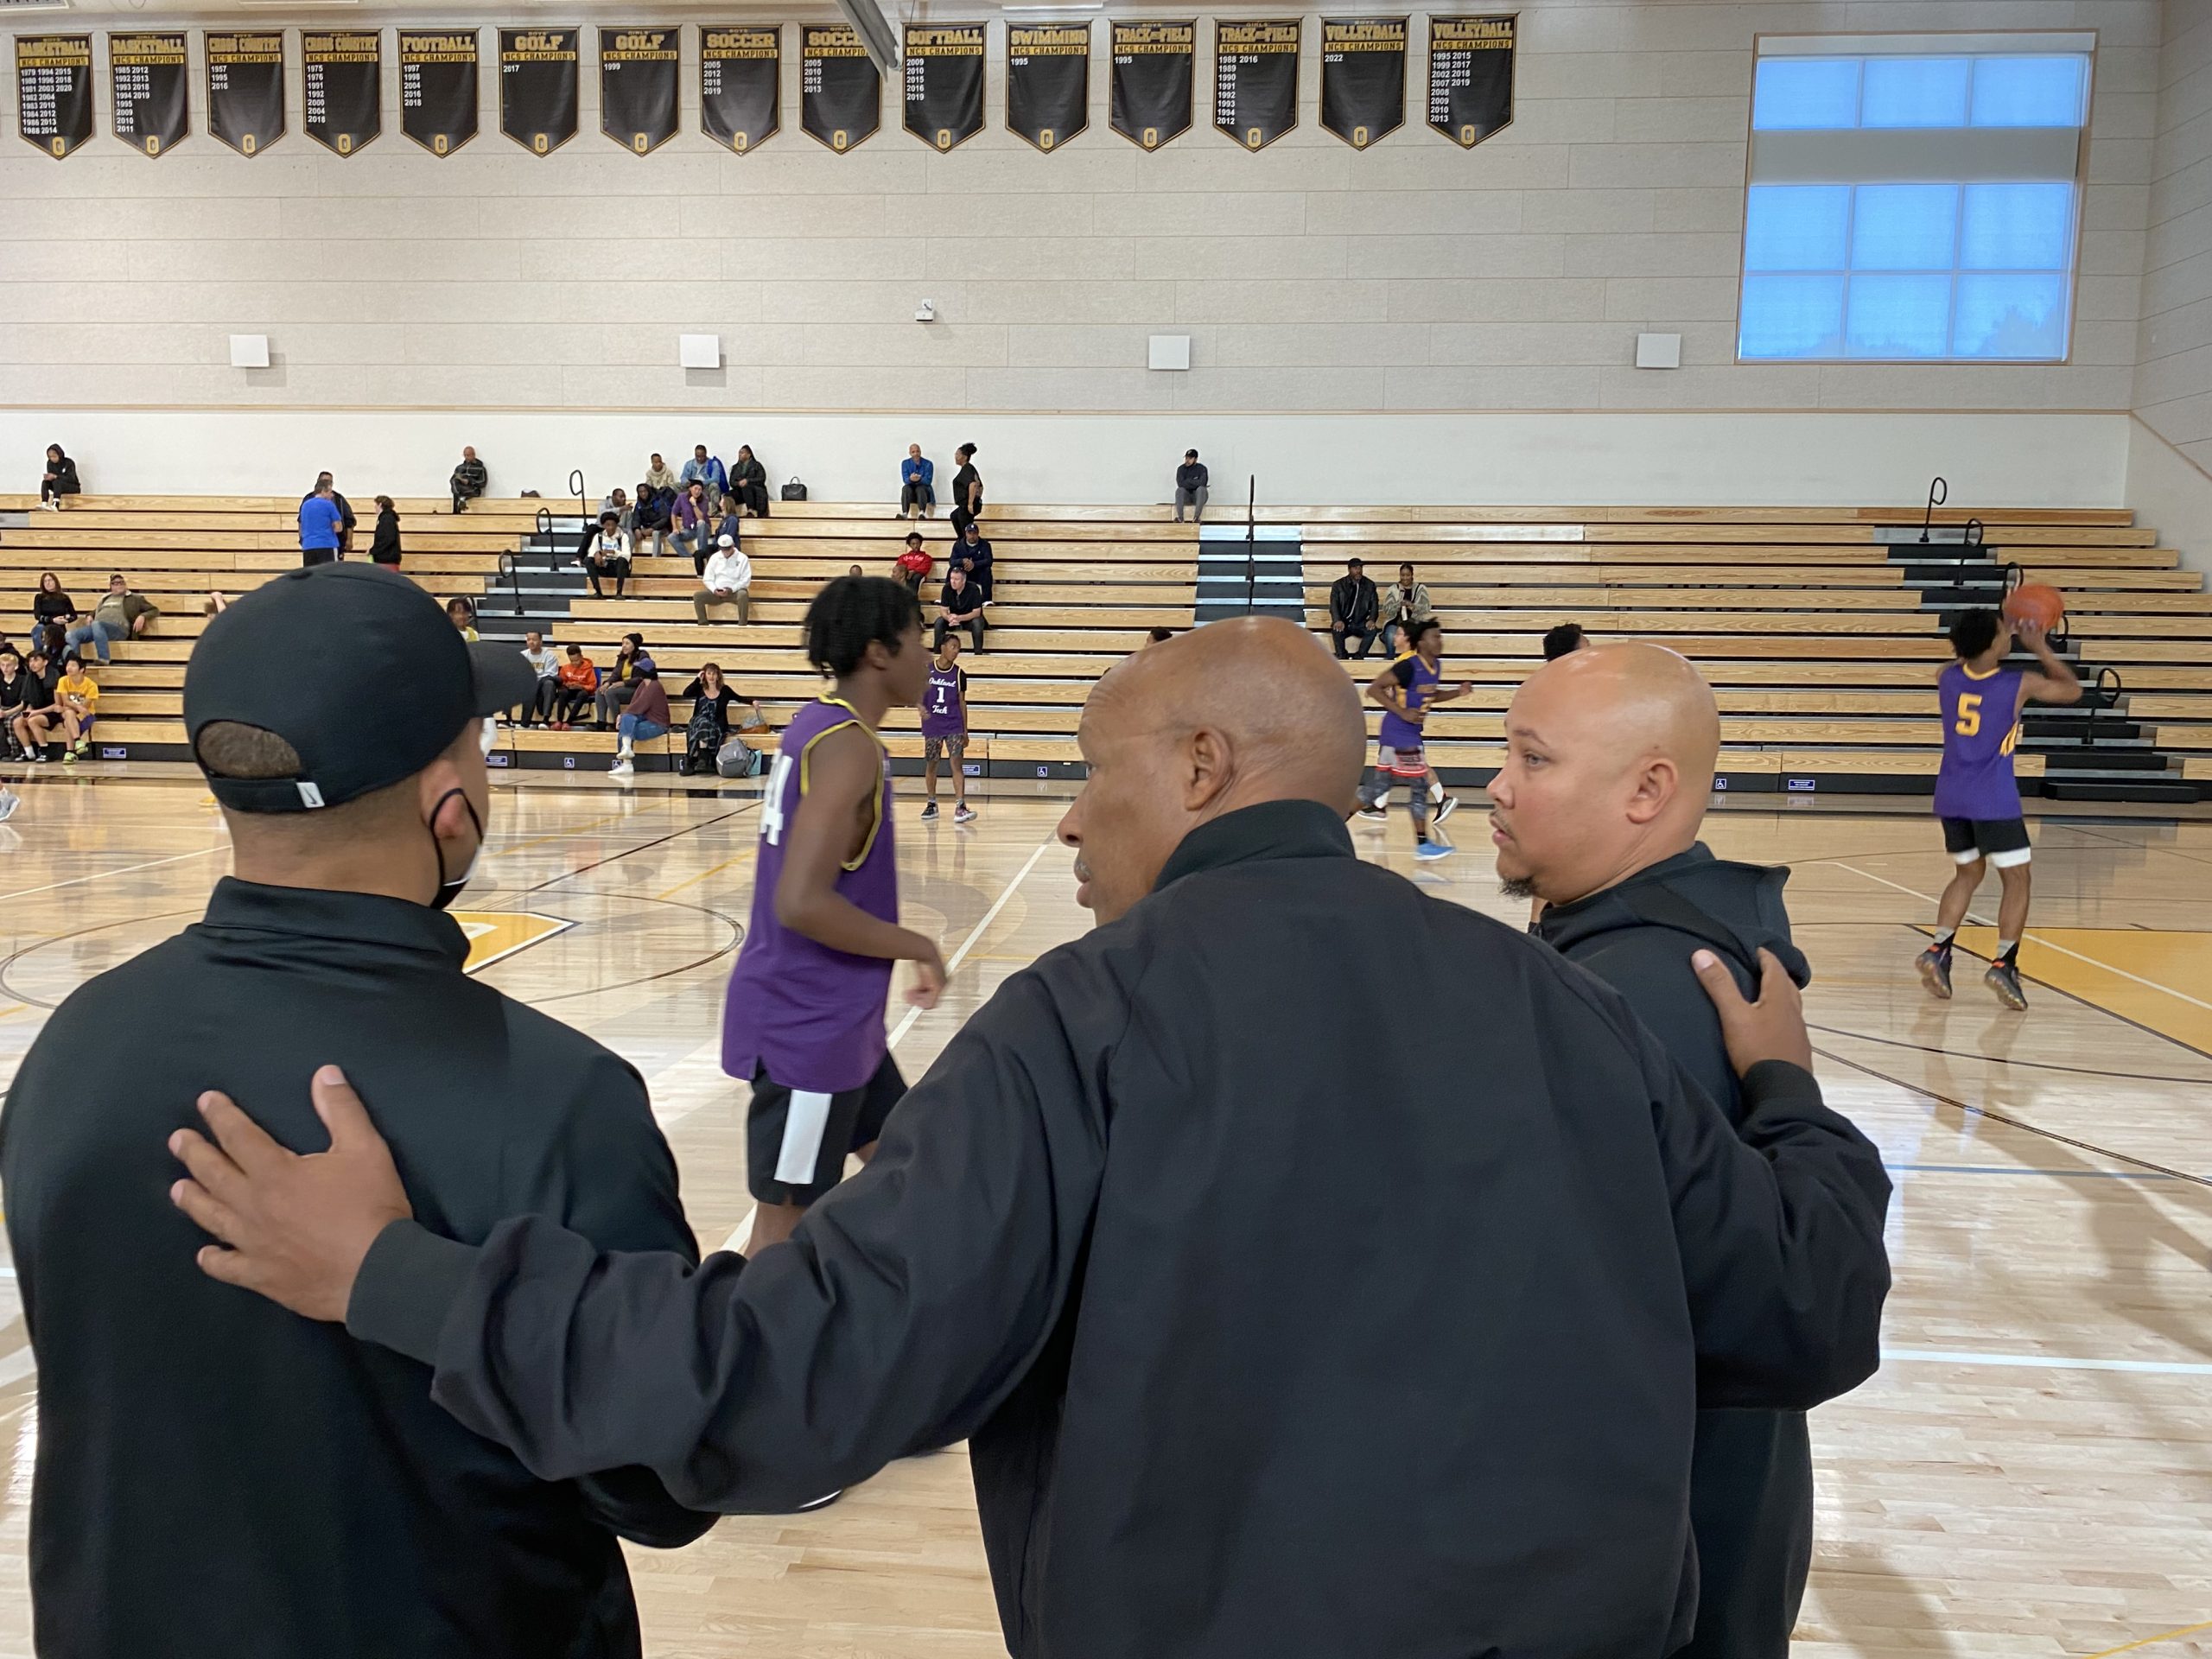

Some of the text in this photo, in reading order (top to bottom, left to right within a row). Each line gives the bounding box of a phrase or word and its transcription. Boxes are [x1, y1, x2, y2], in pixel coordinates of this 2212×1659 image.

[402, 36, 475, 52] FOOTBALL
[515, 35, 563, 51] GOLF
[616, 35, 665, 50] GOLF
[707, 33, 775, 48] SOCCER
[808, 31, 864, 46] SOCC
[907, 29, 983, 45] SOFTBALL
[929, 677, 956, 687] Oakland
[936, 687, 944, 703] 1
[932, 705, 947, 714] Tech
[1955, 692, 1982, 737] 5
